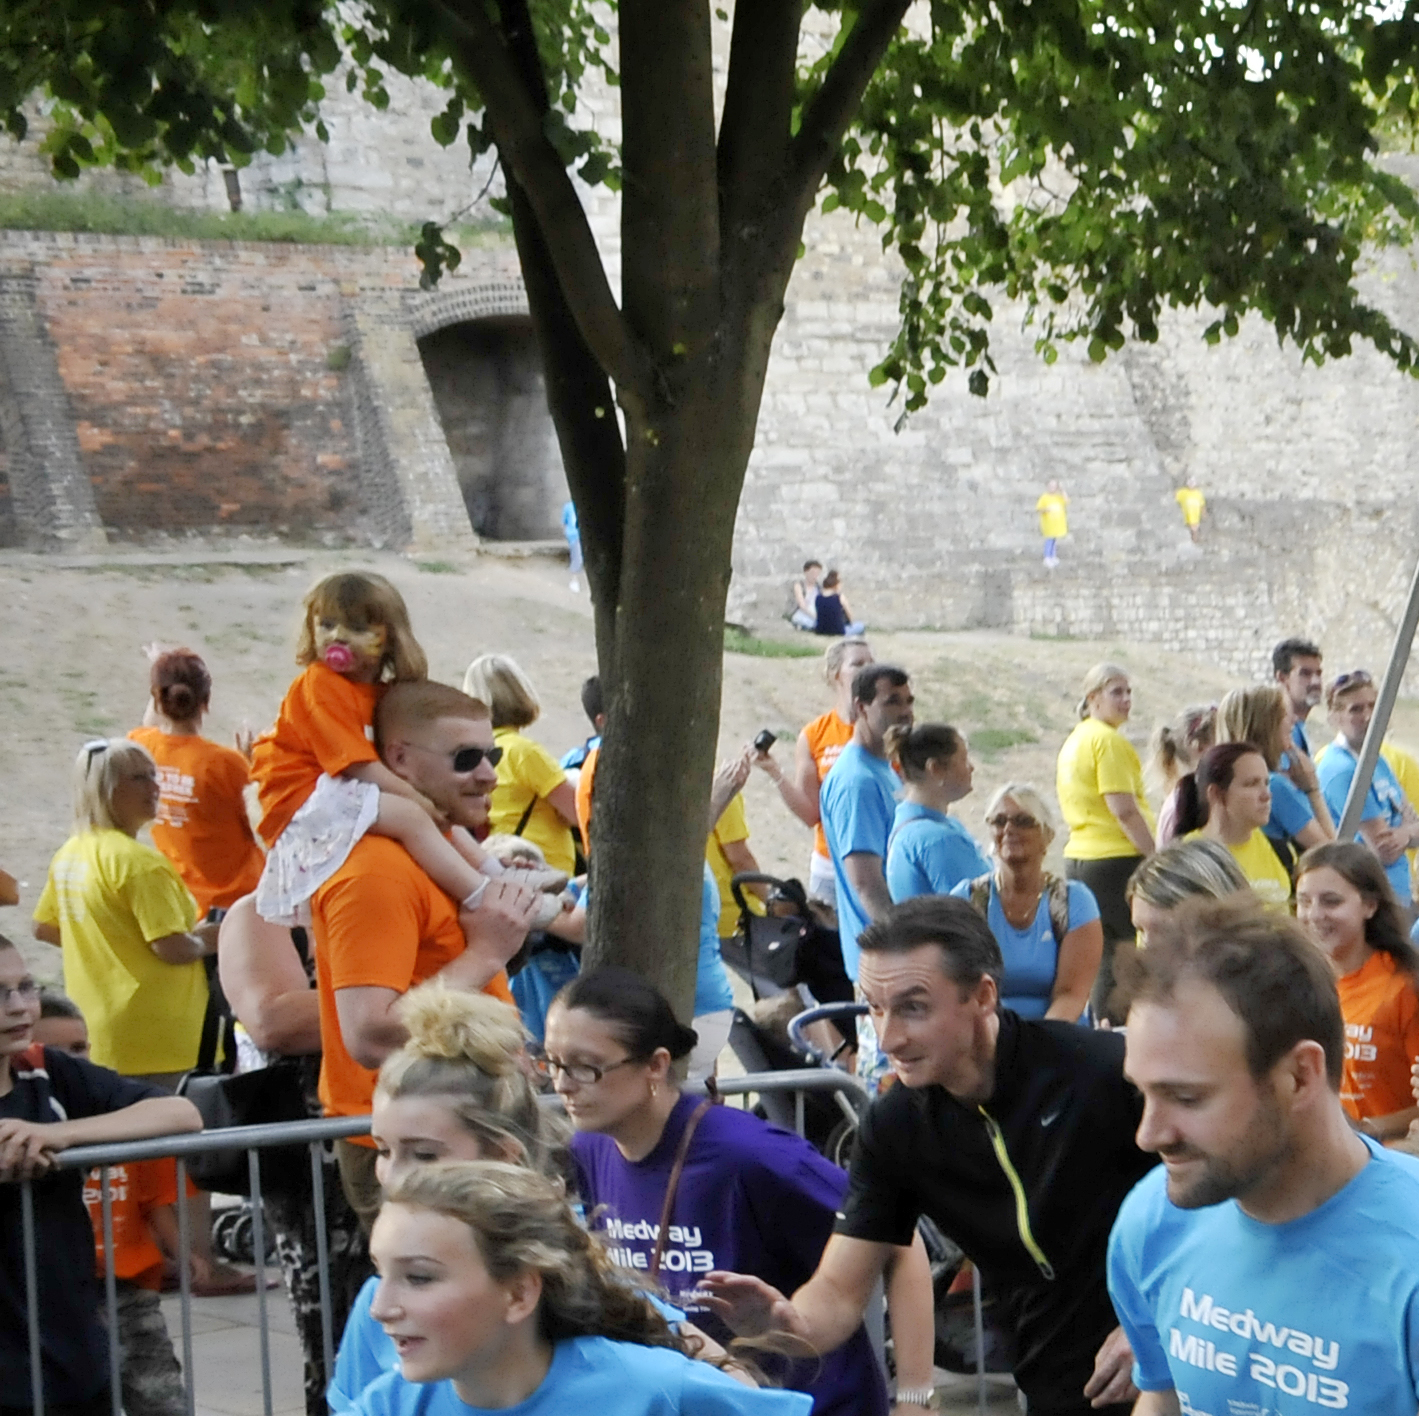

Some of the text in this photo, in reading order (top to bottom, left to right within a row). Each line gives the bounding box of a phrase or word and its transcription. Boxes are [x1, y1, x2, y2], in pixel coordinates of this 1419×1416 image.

[1345, 1042, 1377, 1061] 013
[1169, 1328, 1350, 1409] Mile 2013
[1180, 1288, 1340, 1370] Medway
